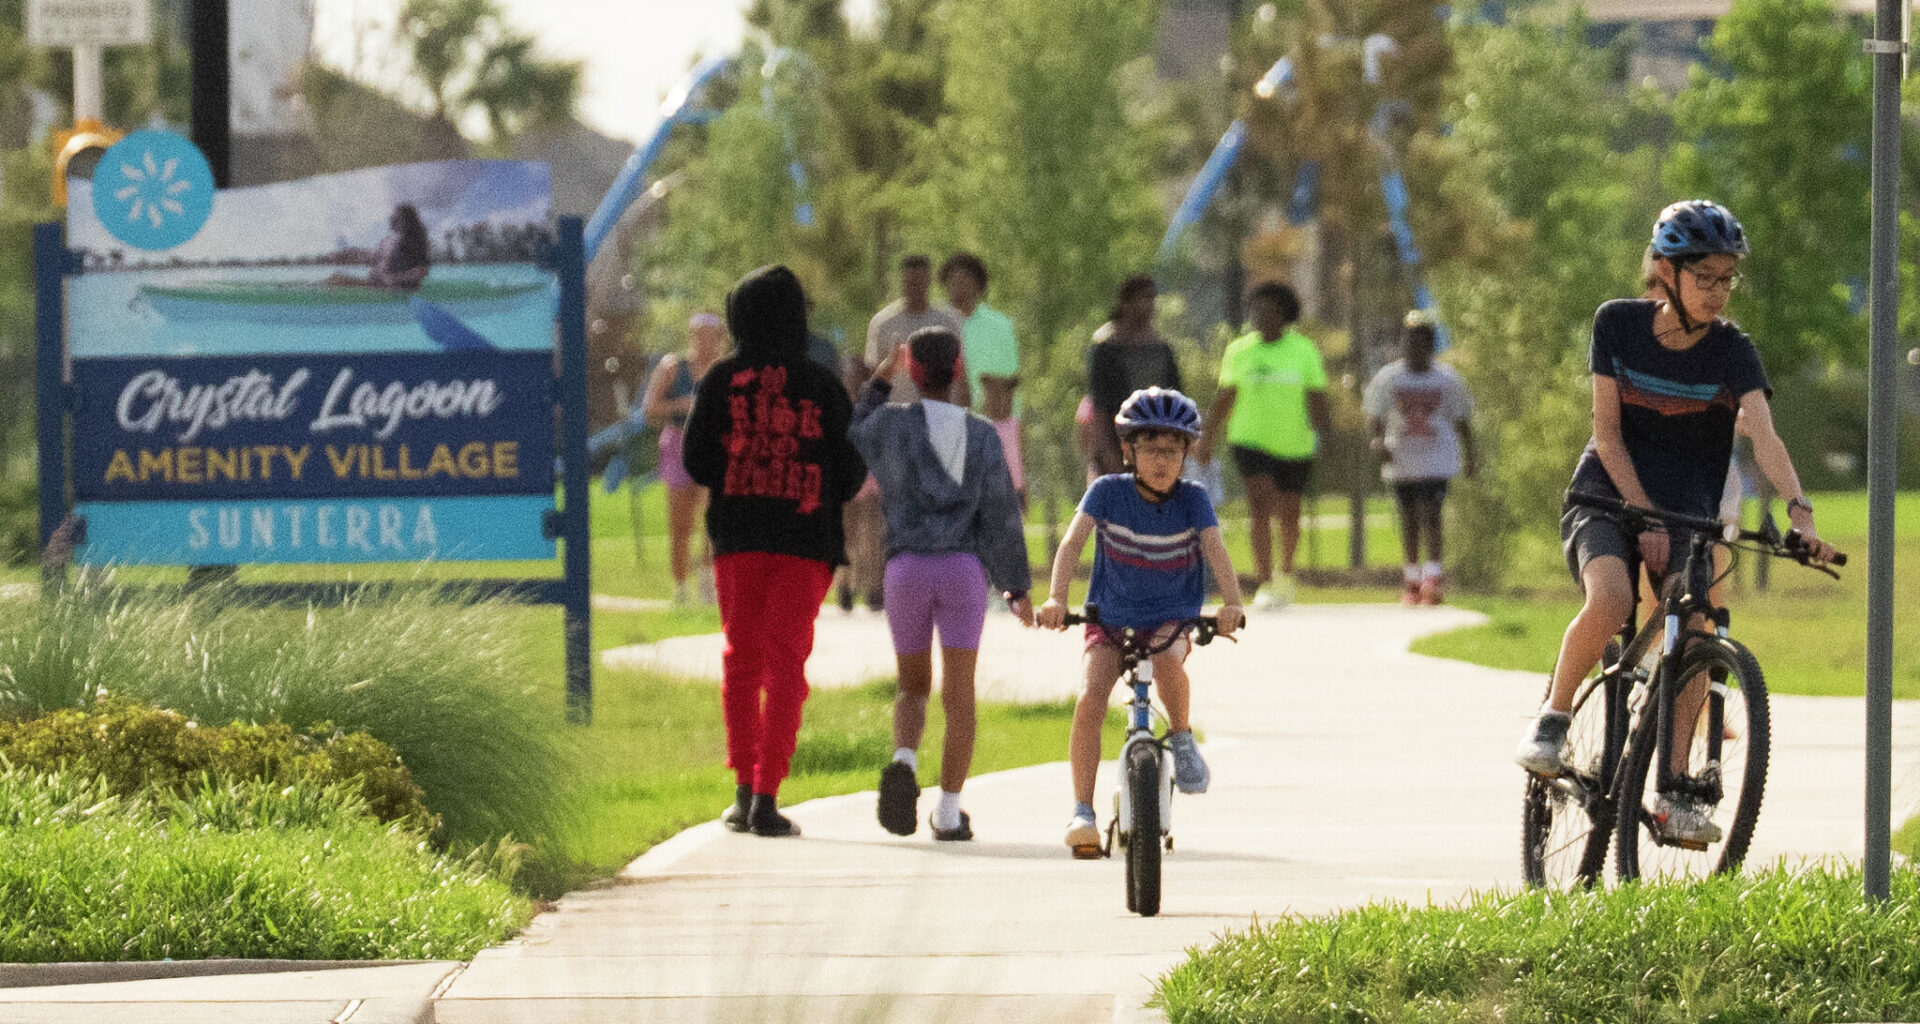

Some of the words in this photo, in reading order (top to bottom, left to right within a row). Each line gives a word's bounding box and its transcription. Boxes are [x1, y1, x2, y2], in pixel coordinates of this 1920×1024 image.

[116, 367, 310, 443] Crystal
[308, 367, 504, 441] Lagoon
[104, 445, 311, 484] AMENITY
[324, 441, 519, 481] VILLAGE
[188, 504, 437, 551] SUNTERRA
